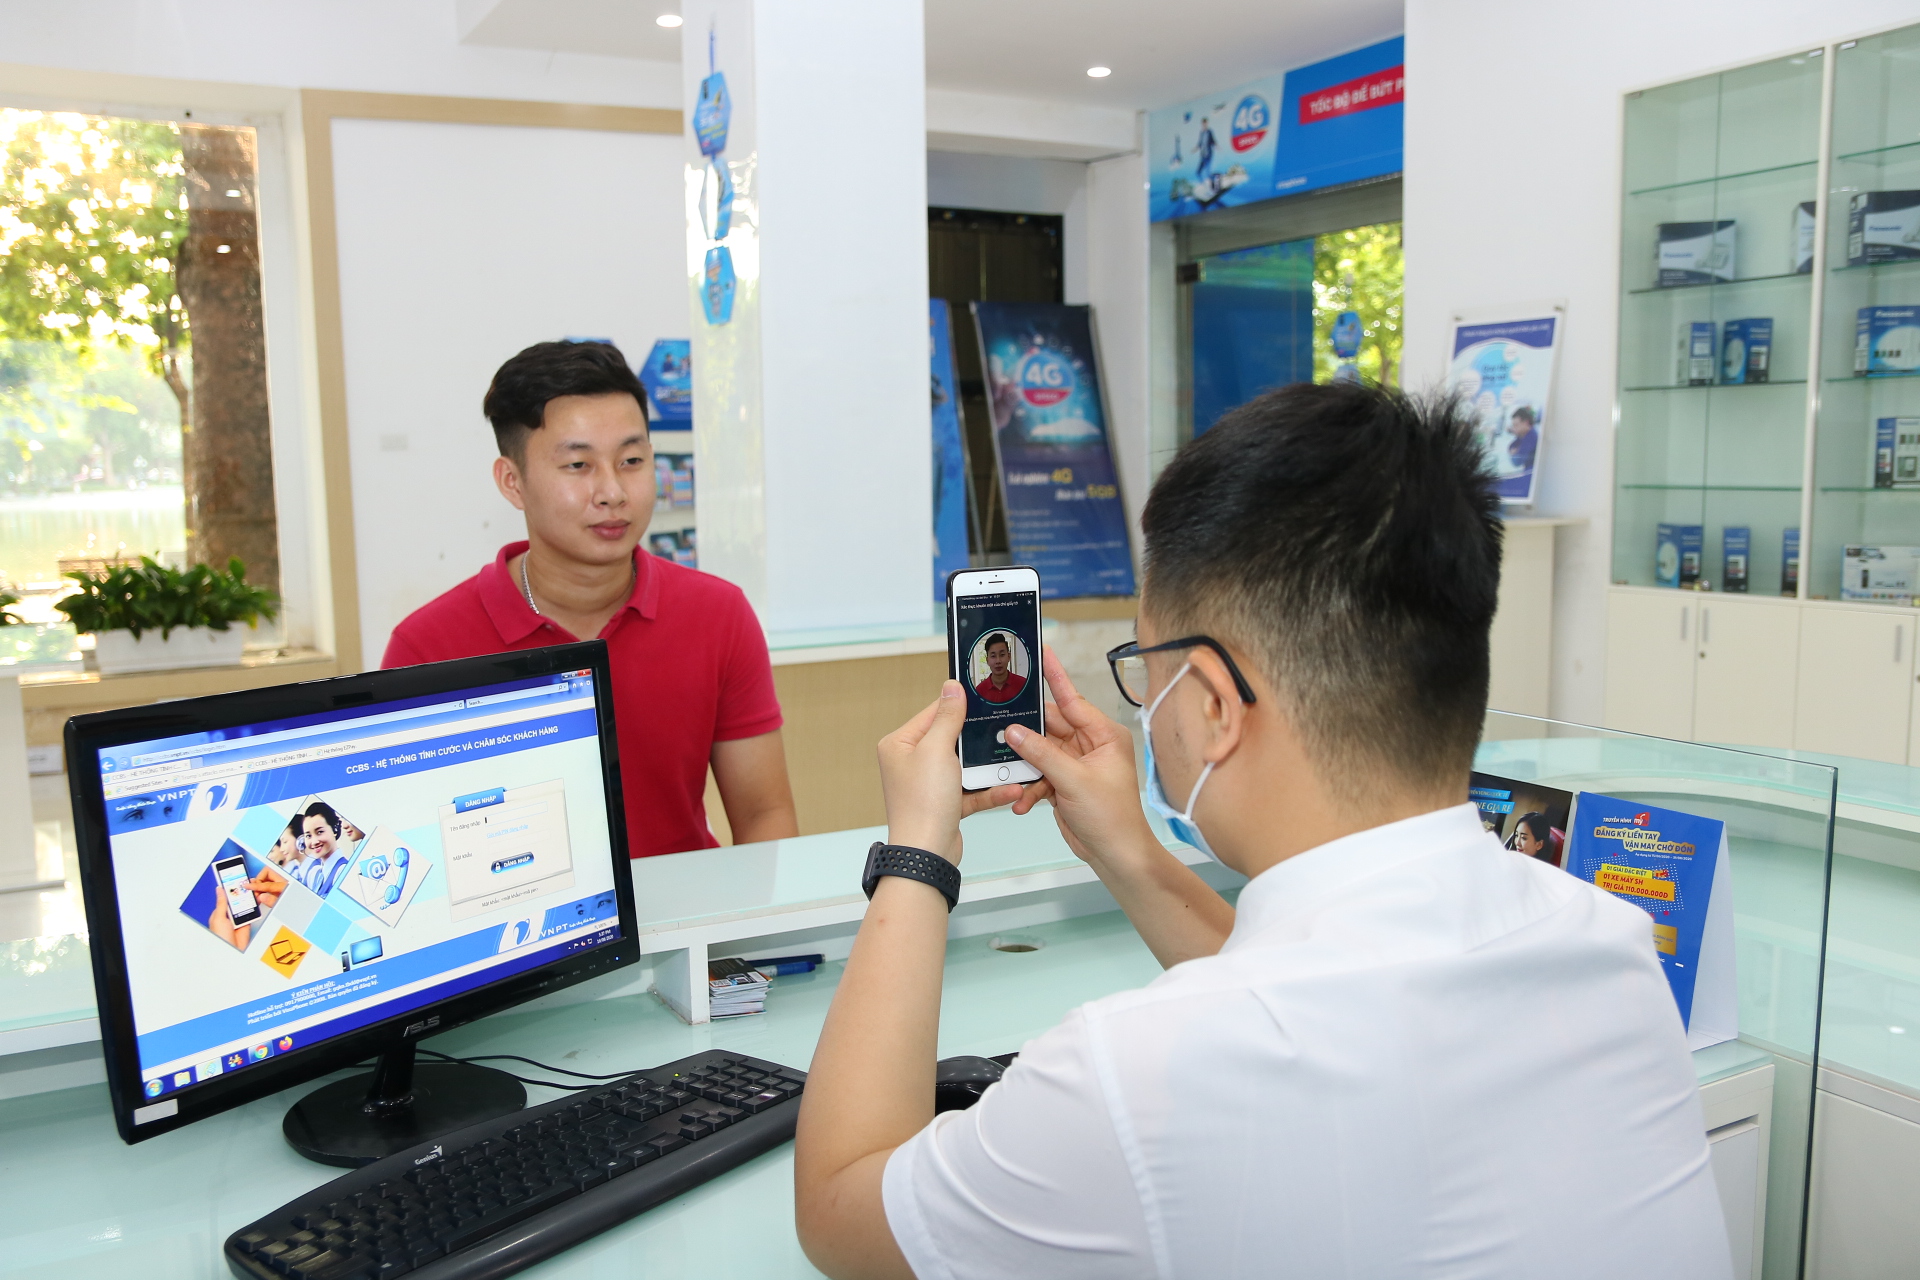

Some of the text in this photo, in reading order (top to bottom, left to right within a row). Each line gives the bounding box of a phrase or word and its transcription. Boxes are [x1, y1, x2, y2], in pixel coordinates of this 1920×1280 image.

[1235, 104, 1264, 131] 4G
[1026, 362, 1063, 386] 4G
[1050, 467, 1073, 484] 4G
[346, 763, 370, 775] CCBS
[376, 757, 388, 769] HỆ
[389, 751, 418, 766] THỐNG
[419, 748, 437, 760] TÍNH
[438, 743, 461, 756] CƯỚC
[462, 740, 473, 751] VÀ
[474, 737, 496, 750] CHĂM
[497, 732, 512, 745] SÓC
[514, 727, 538, 741] KHÁCH
[539, 724, 559, 736] HÀNG
[125, 780, 151, 791] Suggested
[157, 788, 197, 802] VNPT
[465, 794, 497, 808] ĐĂNG NHẬP
[1596, 828, 1616, 837] ĐĂNG
[1616, 828, 1627, 837] KÝ
[1644, 832, 1658, 840] TAY
[1625, 839, 1693, 853] VẬN MAY CHỜ ĐÓN
[1613, 865, 1624, 873] GIẢI
[1624, 867, 1635, 875] ĐẶC
[1620, 875, 1634, 884] MÁY
[1603, 881, 1669, 899] TRỊ GIÁ 110.000.000Đ
[541, 922, 569, 938] VNPT
[403, 1015, 440, 1037] ASUS
[414, 1153, 438, 1165] Genius
